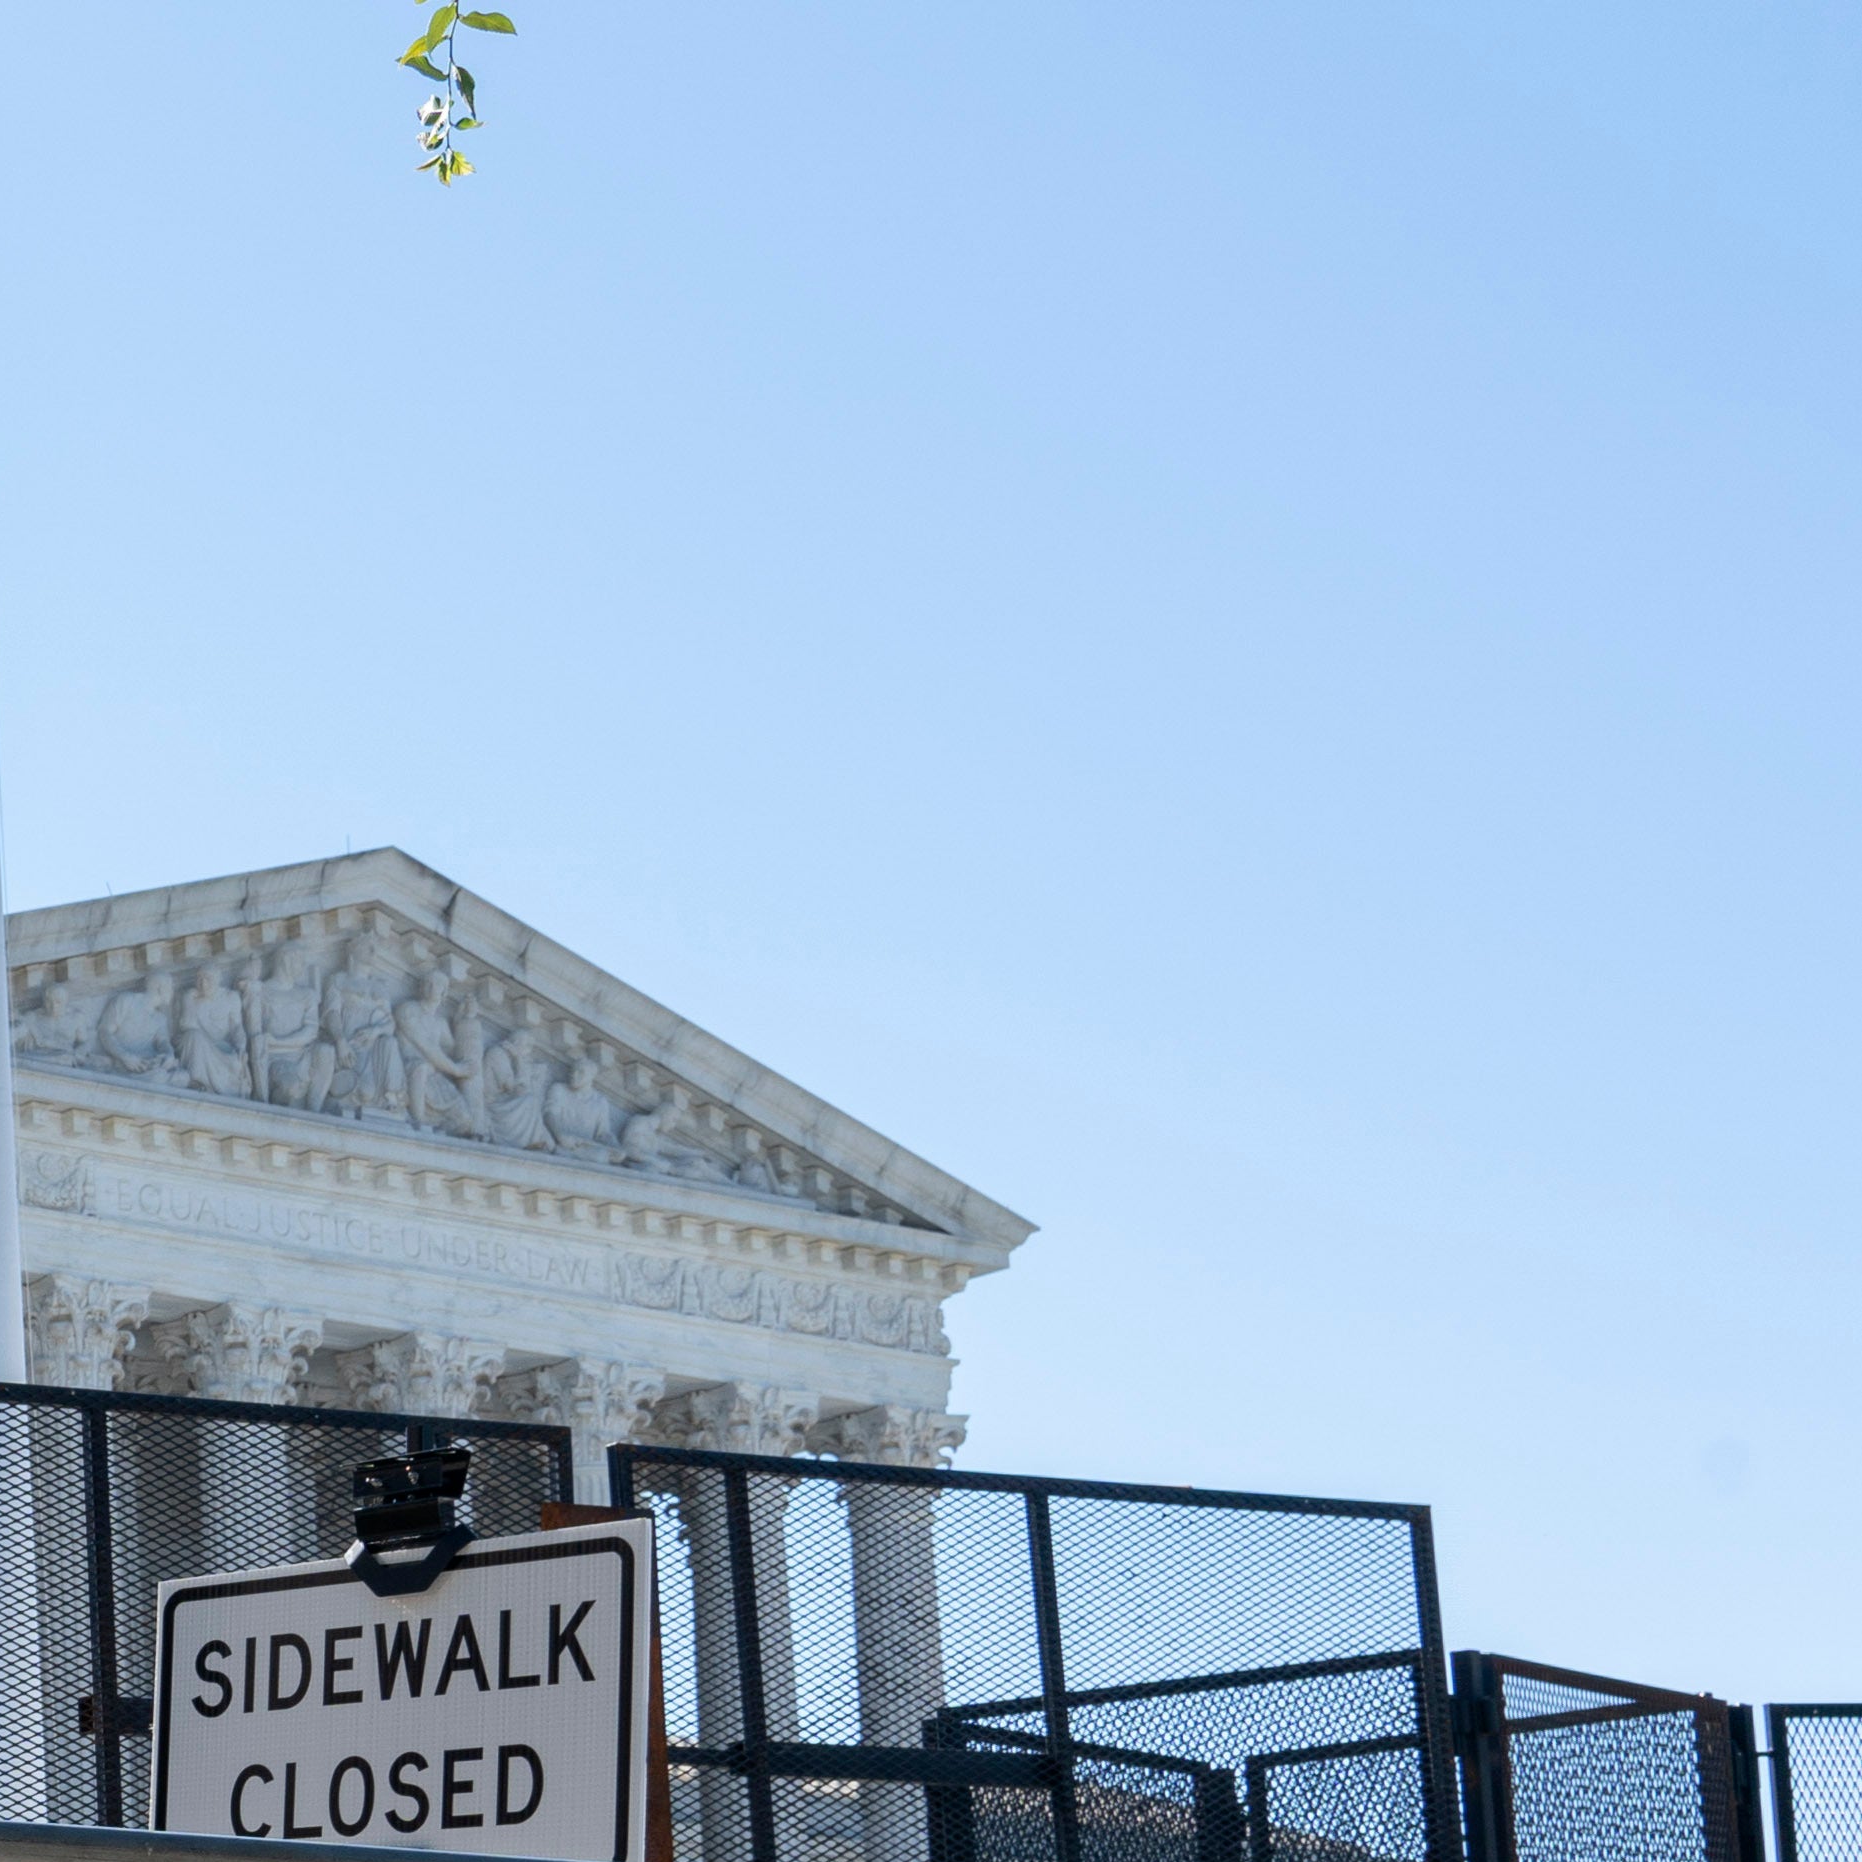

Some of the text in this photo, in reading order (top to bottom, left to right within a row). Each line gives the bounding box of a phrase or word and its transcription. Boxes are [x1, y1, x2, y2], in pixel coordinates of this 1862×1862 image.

[117, 1178, 591, 1286] EQUAL JUSTICE UNDER LAW
[191, 1599, 597, 1718] SIDEWALK
[230, 1744, 544, 1839] CLOSED
